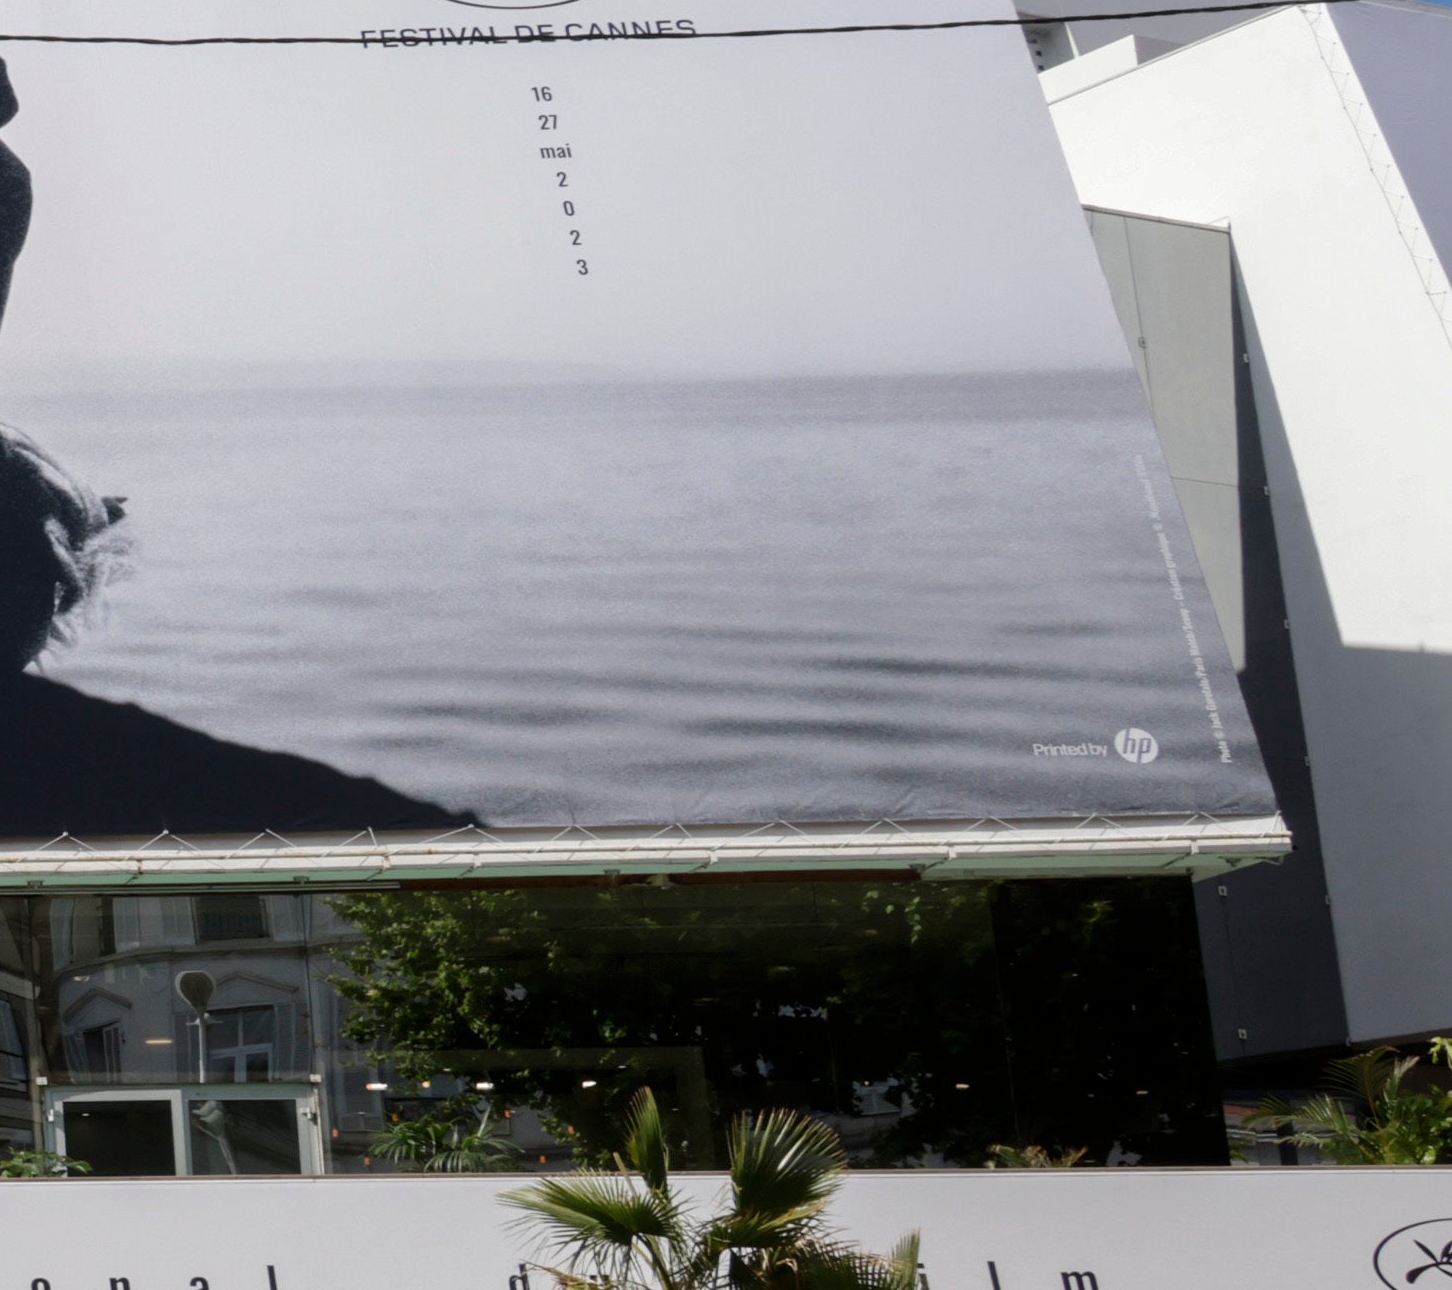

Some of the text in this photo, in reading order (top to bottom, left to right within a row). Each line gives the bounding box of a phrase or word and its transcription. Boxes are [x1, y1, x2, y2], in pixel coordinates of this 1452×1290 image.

[360, 19, 697, 49] FESTIVAL DE CANNES
[531, 85, 553, 104] 16
[537, 113, 558, 131] 27
[539, 143, 572, 160] mai
[1032, 742, 1087, 757] Printed
[1088, 743, 1108, 758] by
